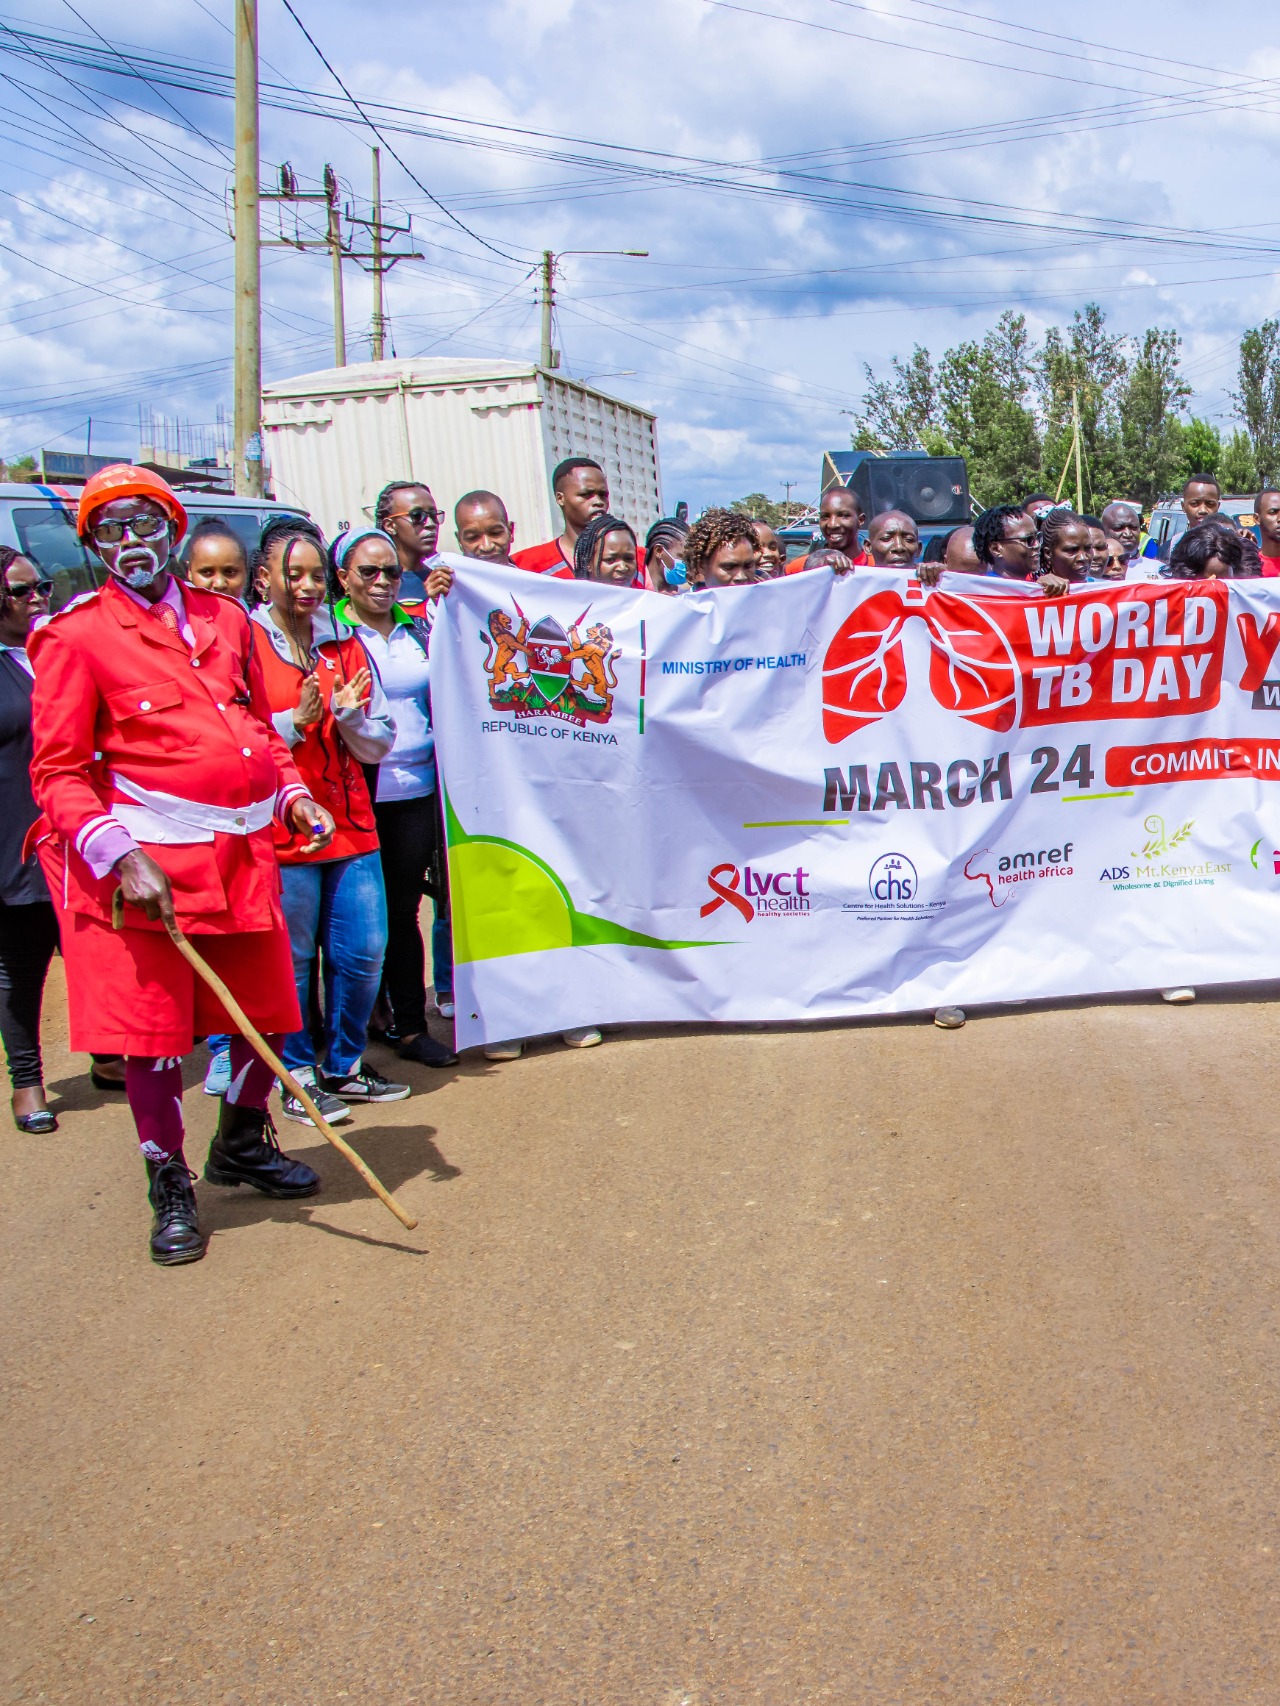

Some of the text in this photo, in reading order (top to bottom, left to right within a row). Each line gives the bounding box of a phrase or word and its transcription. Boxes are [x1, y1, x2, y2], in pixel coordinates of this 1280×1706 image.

[1025, 596, 1217, 656] WORLD
[662, 653, 806, 674] MINISTRY OF HEALTH
[1032, 652, 1213, 709] TB DAY
[517, 709, 582, 726] HARAMBEE
[482, 721, 618, 745] REPUBLIC OF KENYA
[1131, 749, 1234, 776] COMMIT
[823, 744, 1094, 812] MARCH 24
[998, 842, 1074, 872] amref
[744, 867, 810, 896] lvct
[874, 870, 912, 900] chs
[998, 865, 1074, 885] health africa
[1099, 866, 1130, 881] ADS
[1113, 883, 1152, 891] Wholesome
[1163, 880, 1193, 888] Dignified
[1194, 878, 1214, 886] Living
[758, 896, 811, 911] health
